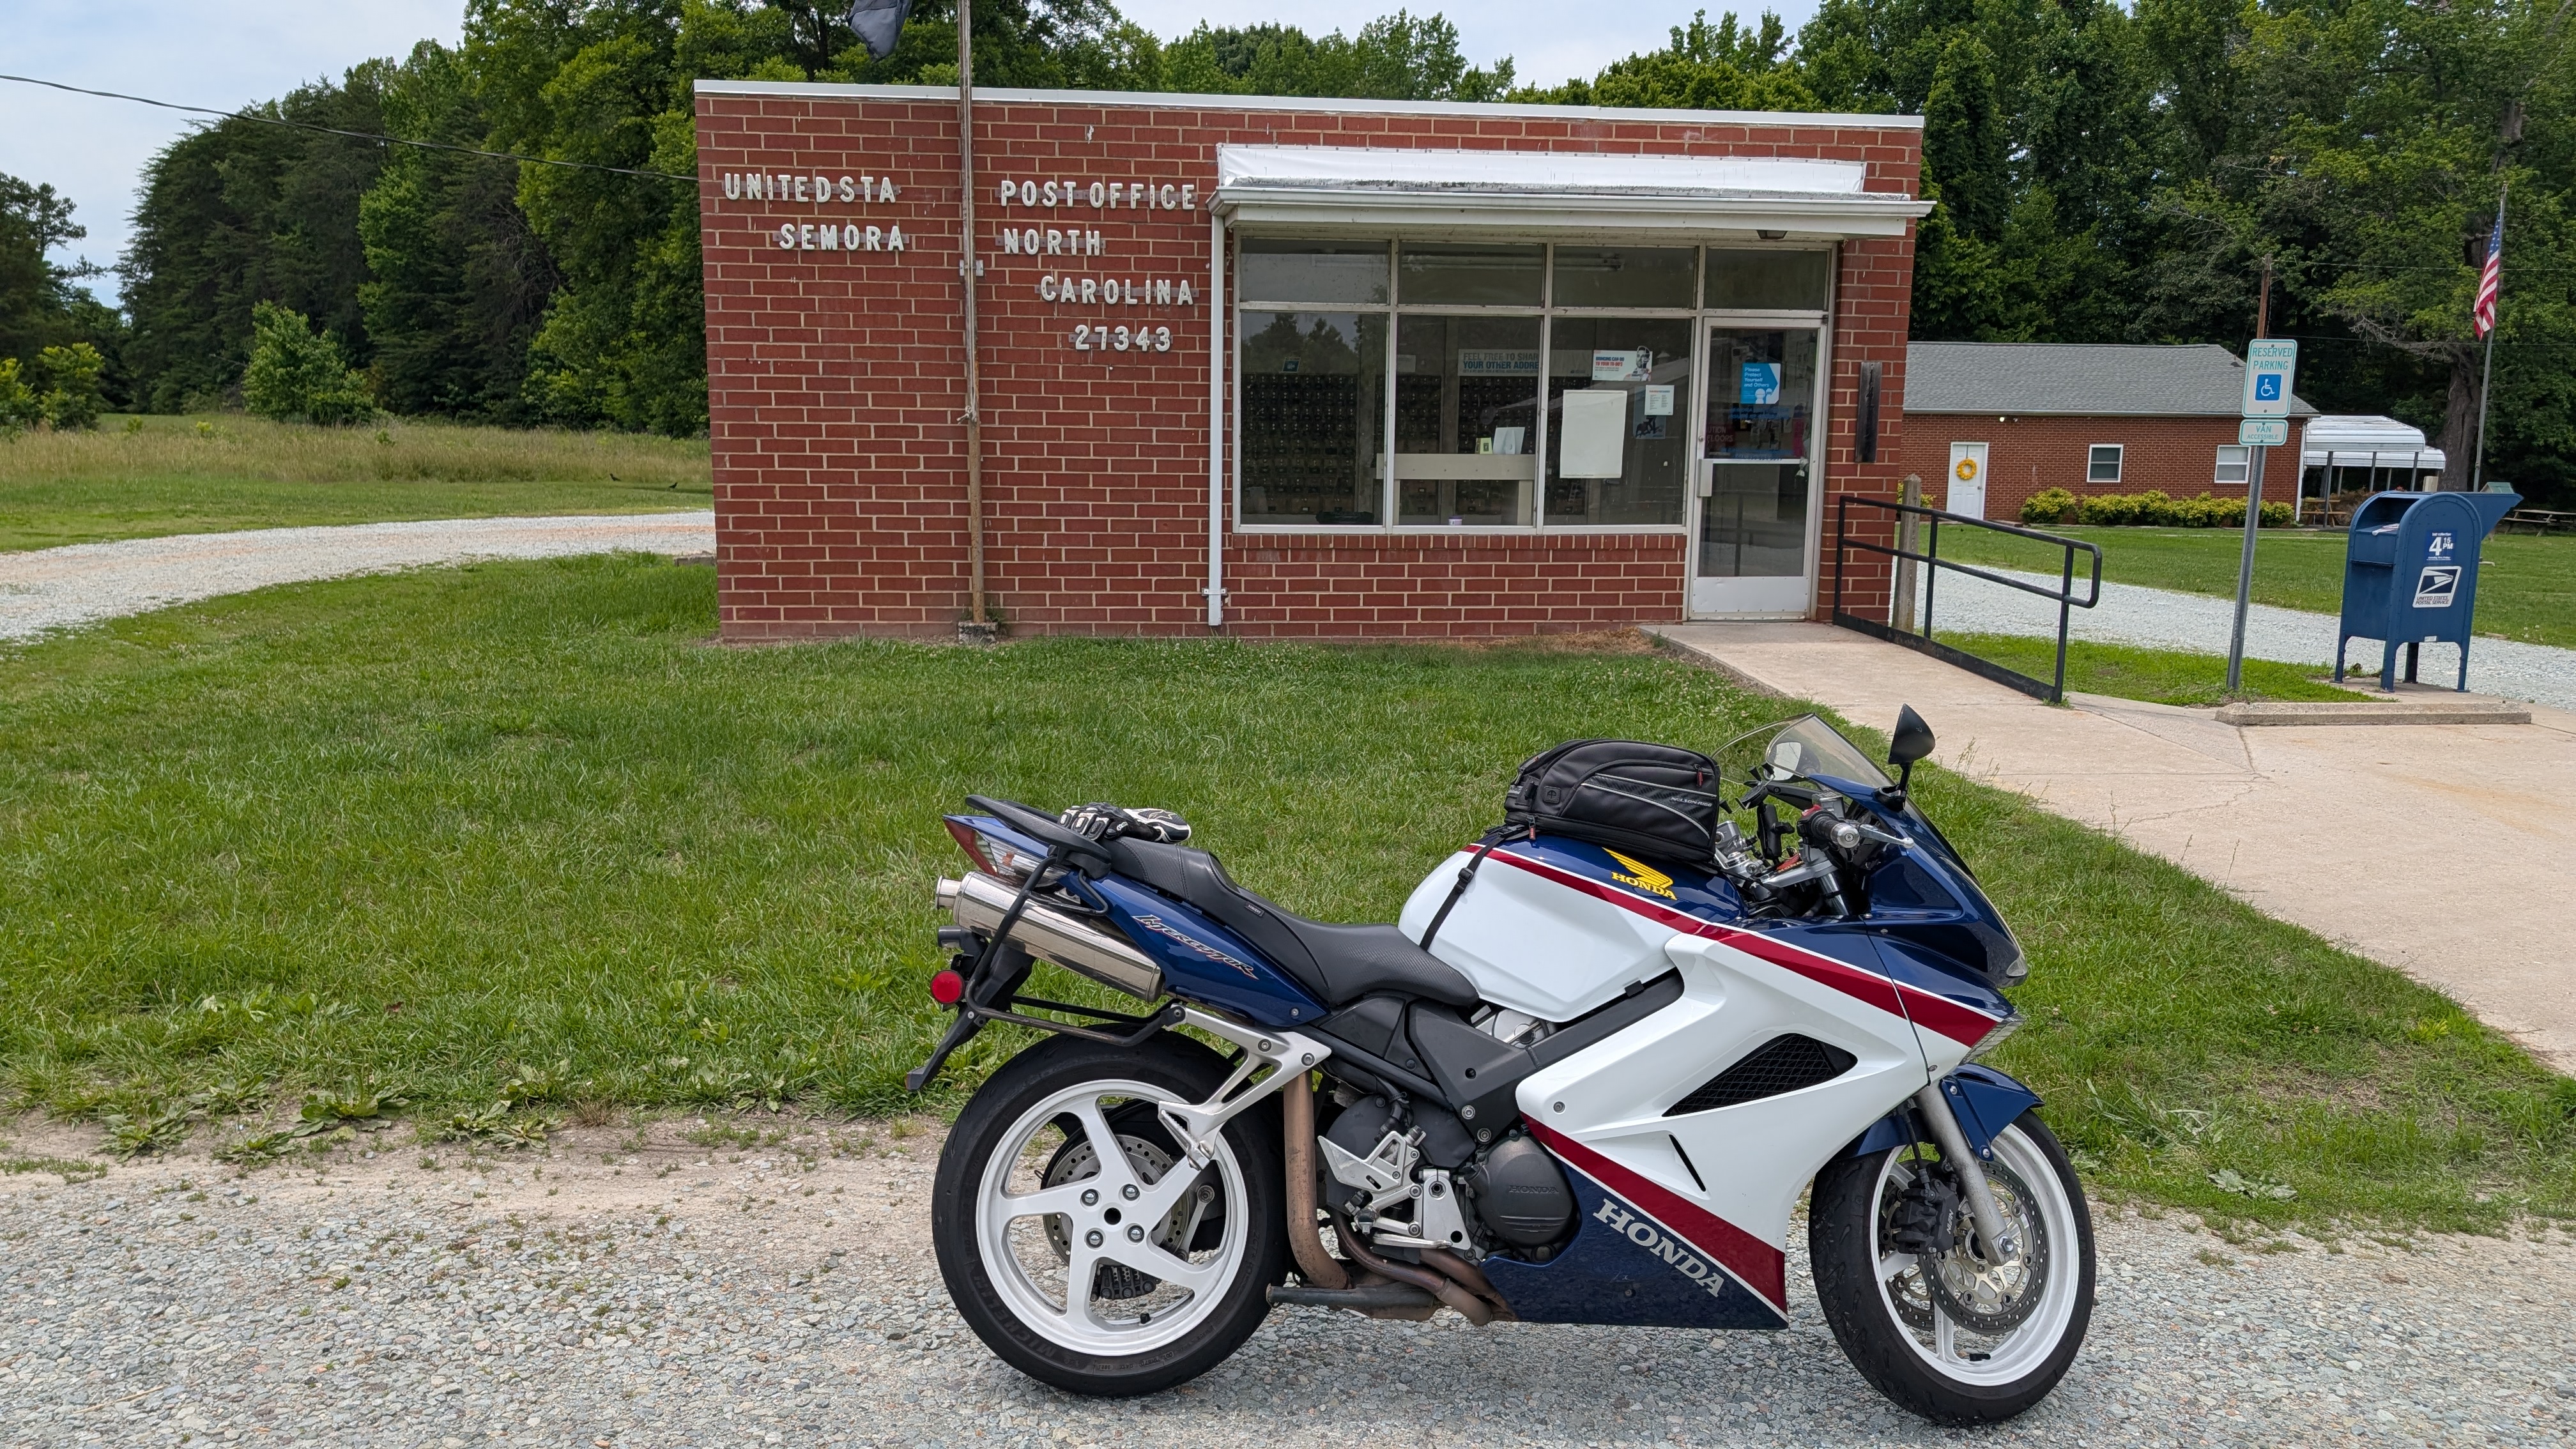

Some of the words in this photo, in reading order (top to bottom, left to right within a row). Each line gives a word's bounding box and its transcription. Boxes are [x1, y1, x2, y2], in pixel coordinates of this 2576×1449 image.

[1001, 180, 1077, 208] POST
[1089, 182, 1195, 210] OFFICE
[779, 224, 905, 252] SEMORA
[1004, 228, 1101, 256] NORTH
[1040, 275, 1193, 306] CAROLINA
[1075, 325, 1171, 352] 27343
[2252, 347, 2293, 357] RESERVED
[1463, 361, 1483, 369] YOUR
[1486, 361, 1512, 369] OTHER
[1464, 353, 1482, 361] FEEL
[1517, 353, 1539, 362] SHAR
[2253, 360, 2288, 370] PARKING
[2429, 537, 2442, 556] 4
[1611, 871, 1677, 900] HONDA
[1509, 1184, 1559, 1194] HONDA
[1593, 1199, 1726, 1298] HONDA
[974, 1276, 1056, 1358] MICHELIN
